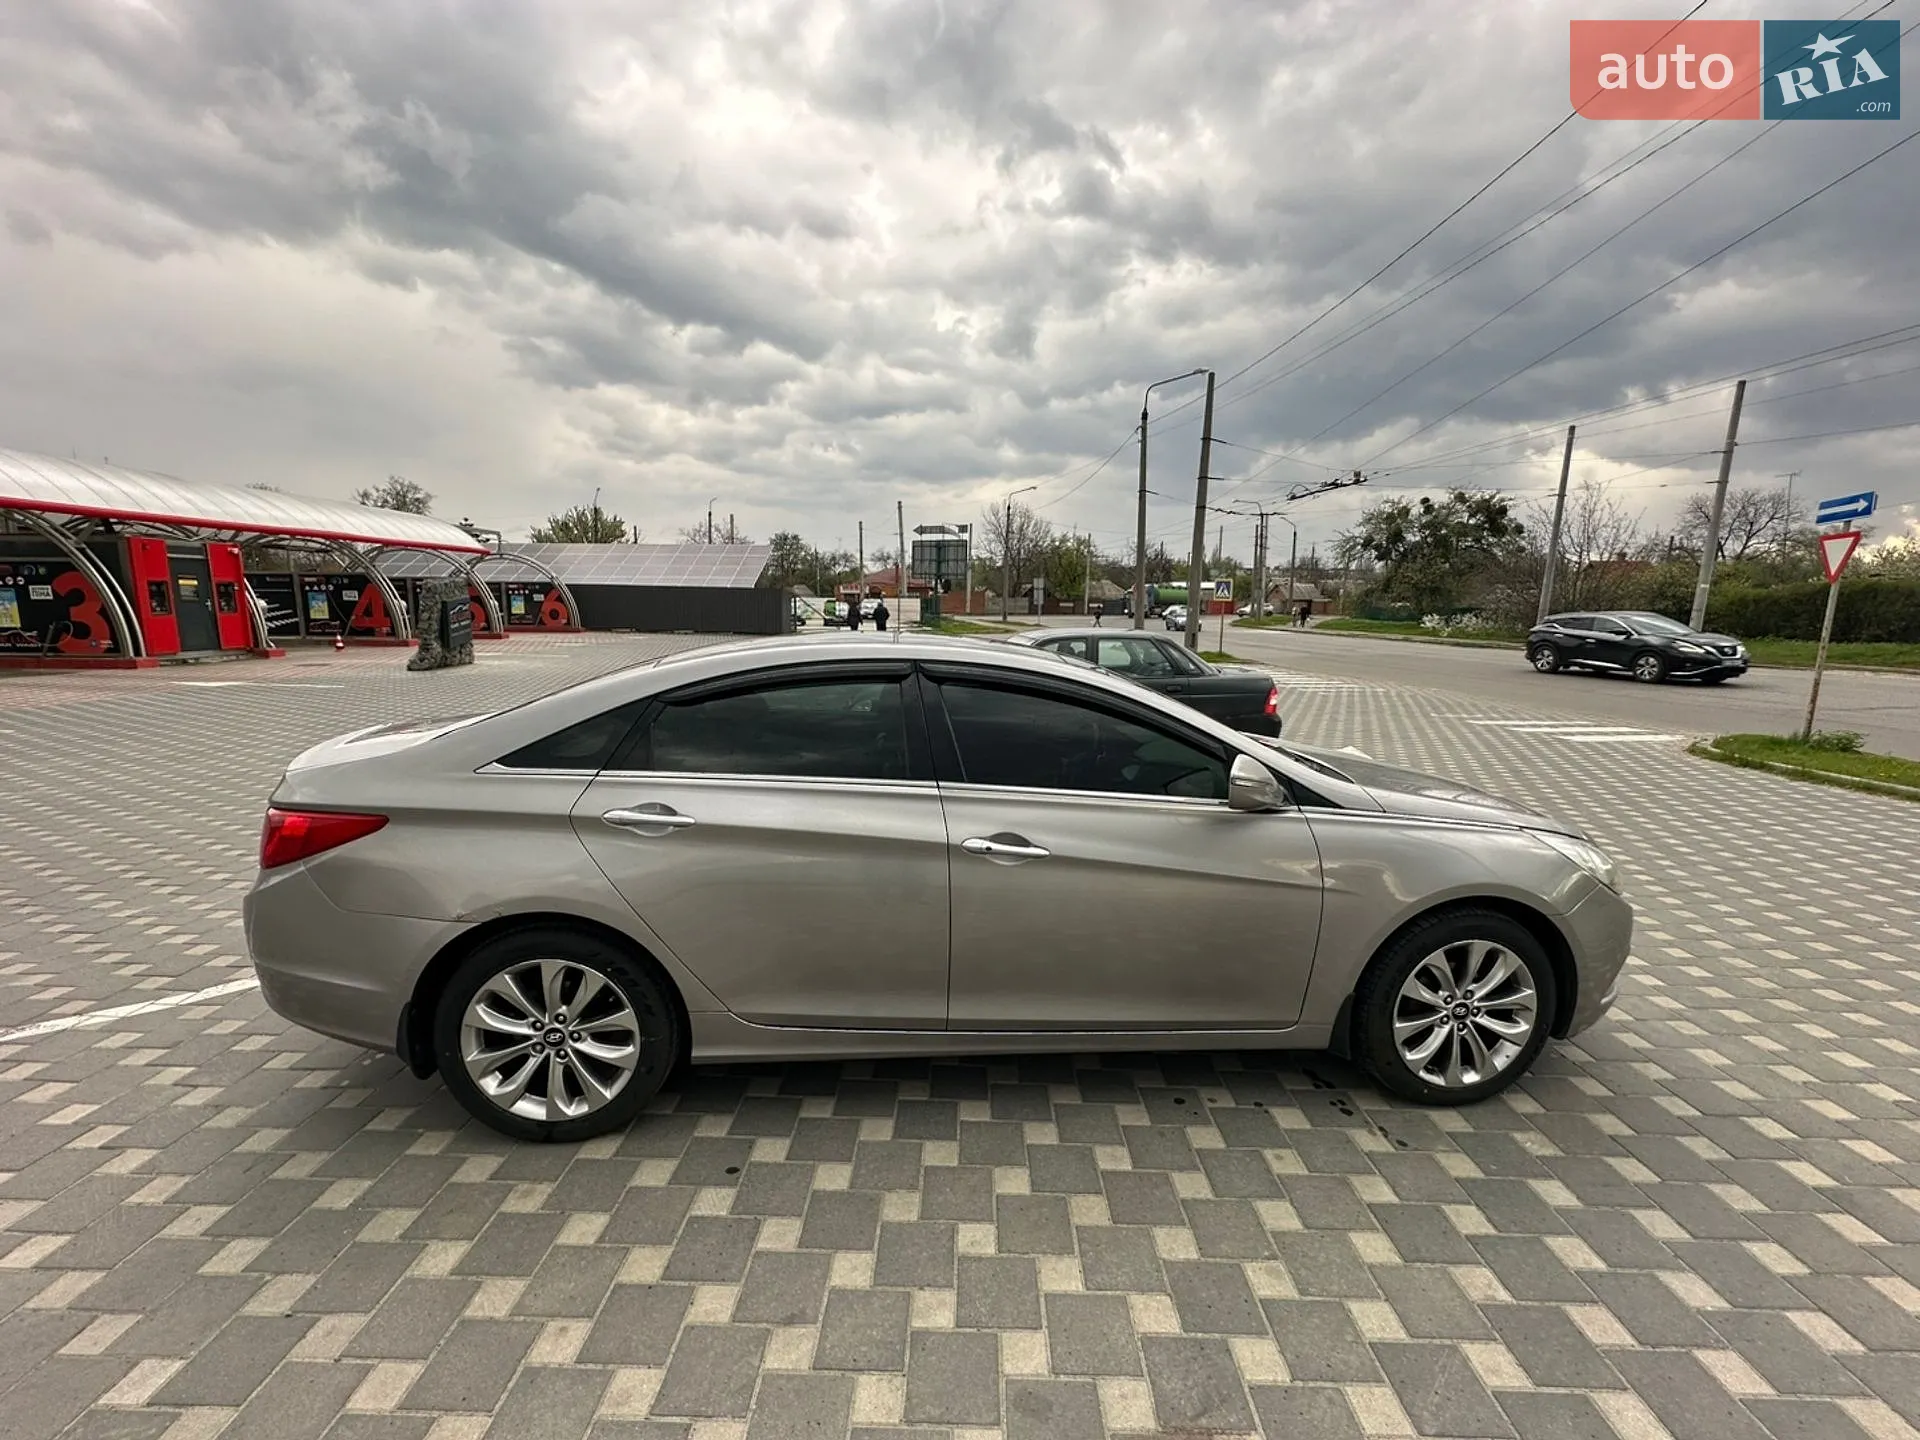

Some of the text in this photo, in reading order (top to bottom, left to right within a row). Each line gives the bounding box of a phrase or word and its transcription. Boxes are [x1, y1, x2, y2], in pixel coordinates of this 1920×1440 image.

[52, 571, 110, 654] 3
[351, 583, 392, 637] 4
[540, 588, 569, 628] 6
